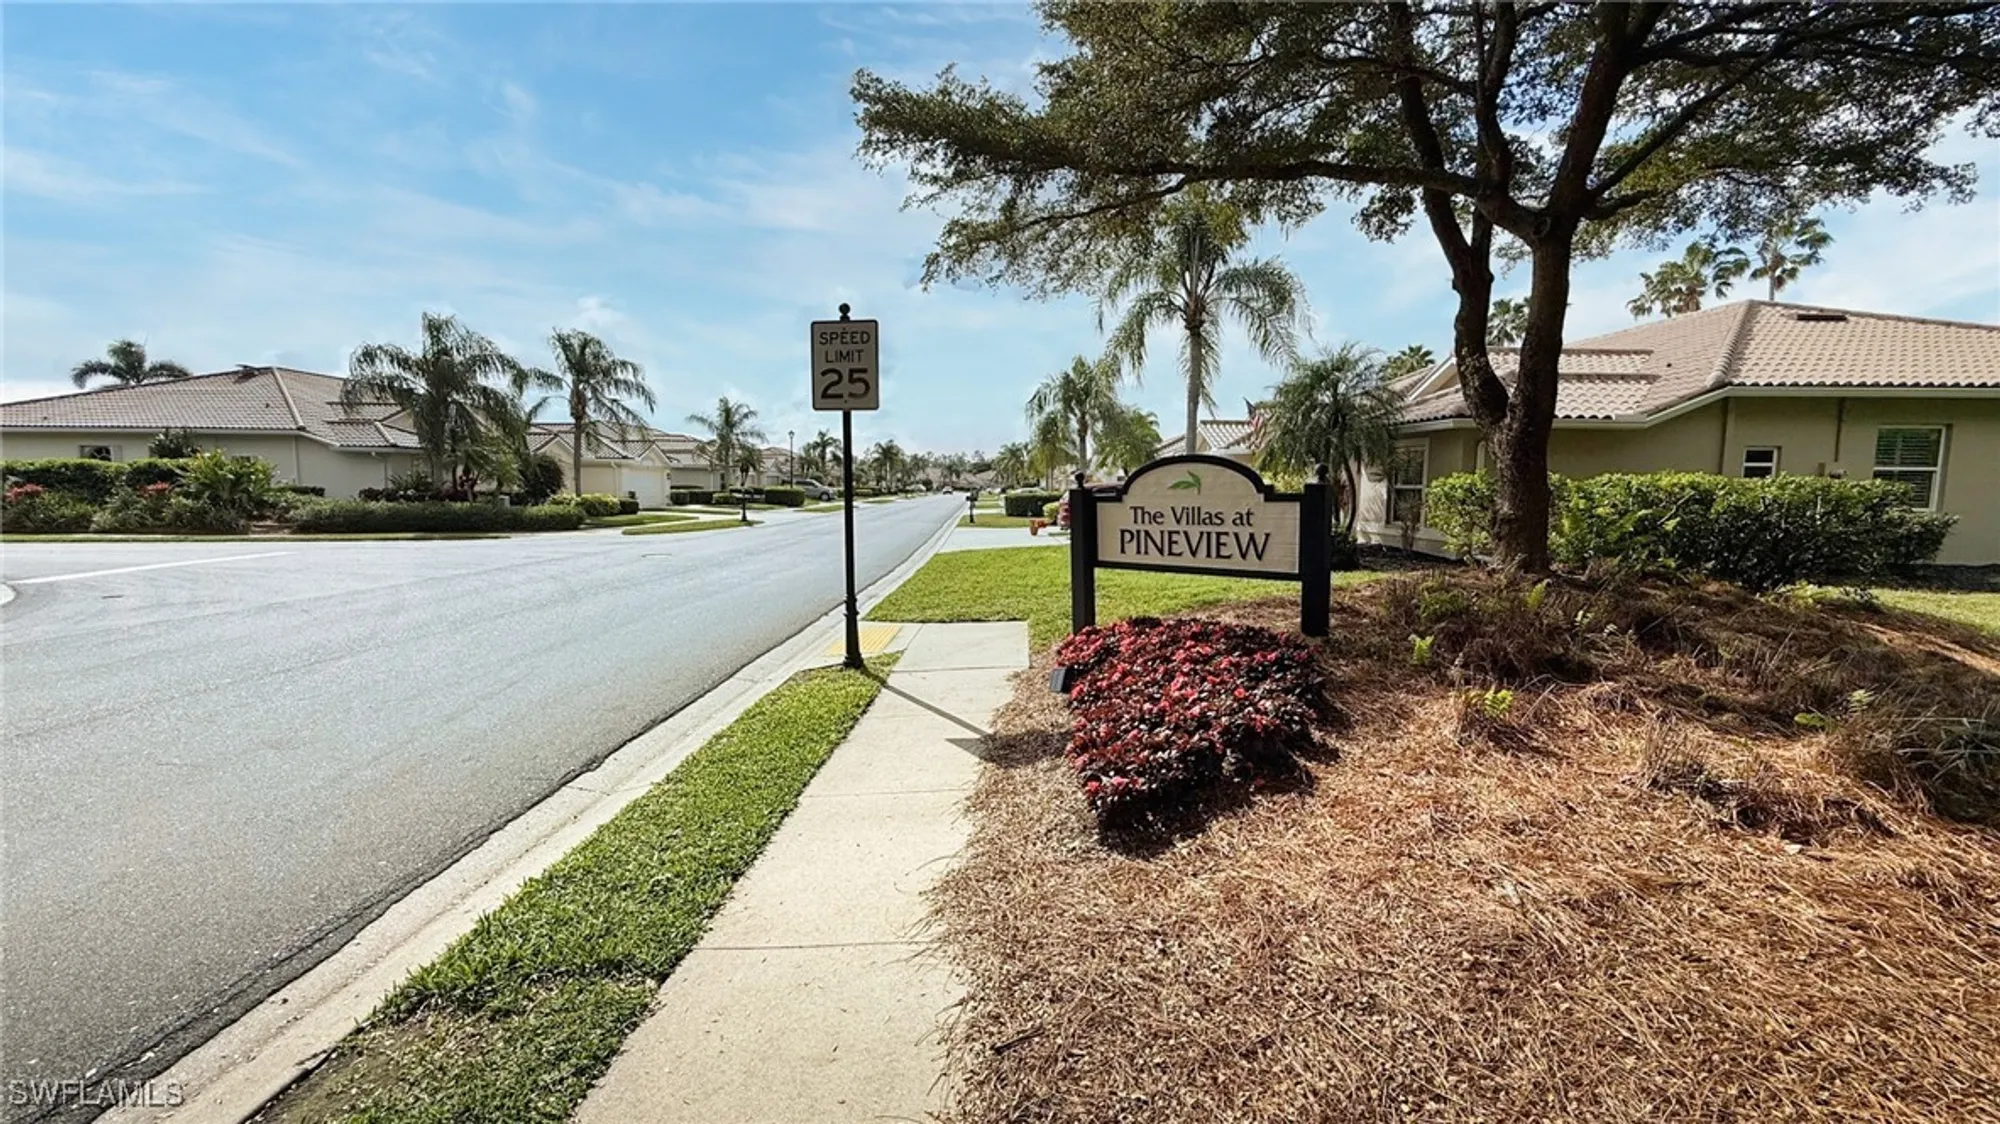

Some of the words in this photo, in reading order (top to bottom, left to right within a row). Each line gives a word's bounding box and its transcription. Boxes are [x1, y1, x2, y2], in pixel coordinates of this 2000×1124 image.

[819, 331, 871, 345] SPEED
[825, 349, 864, 363] LIMIT
[820, 368, 871, 399] 25
[1129, 506, 1164, 525] The
[1171, 506, 1225, 527] Villas
[1232, 508, 1254, 527] at
[1119, 528, 1271, 561] PINEVIEW
